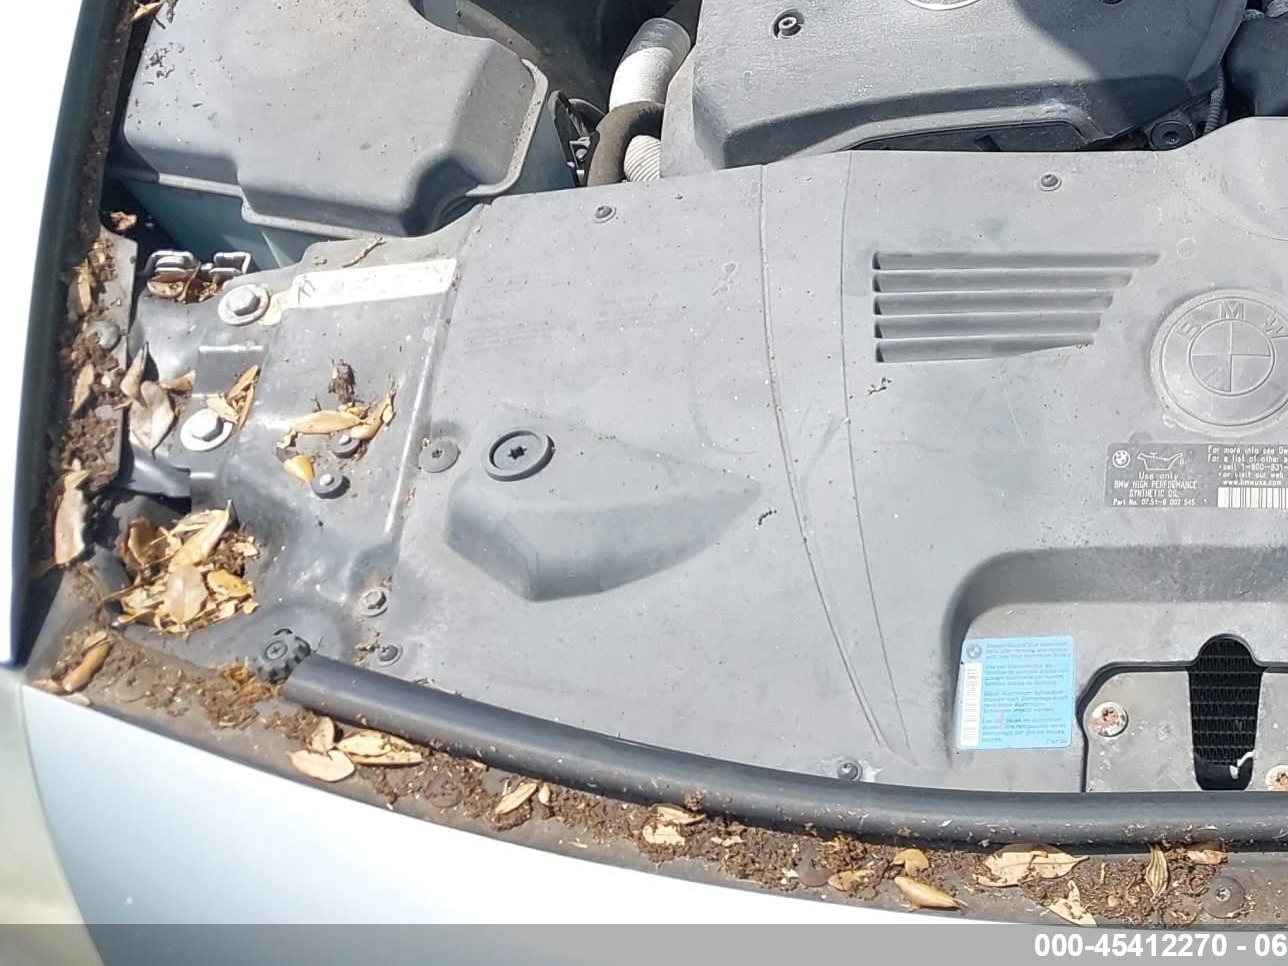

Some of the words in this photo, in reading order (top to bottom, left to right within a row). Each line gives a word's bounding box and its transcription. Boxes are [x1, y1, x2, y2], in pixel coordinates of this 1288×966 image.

[1176, 301, 1288, 341] BMW
[1208, 445, 1220, 454] For
[1245, 446, 1259, 454] info
[1208, 454, 1220, 463] For
[1232, 454, 1245, 462] list
[1261, 454, 1280, 462] other
[1138, 471, 1154, 480] Use
[1160, 472, 1179, 481] only
[1114, 480, 1129, 489] BMW
[1133, 480, 1148, 489] HIGH
[1151, 480, 1198, 490] PERFORMANCE
[1129, 489, 1165, 498] SYNTHETIC
[1168, 489, 1178, 498] OIL
[1112, 498, 1126, 506] Part
